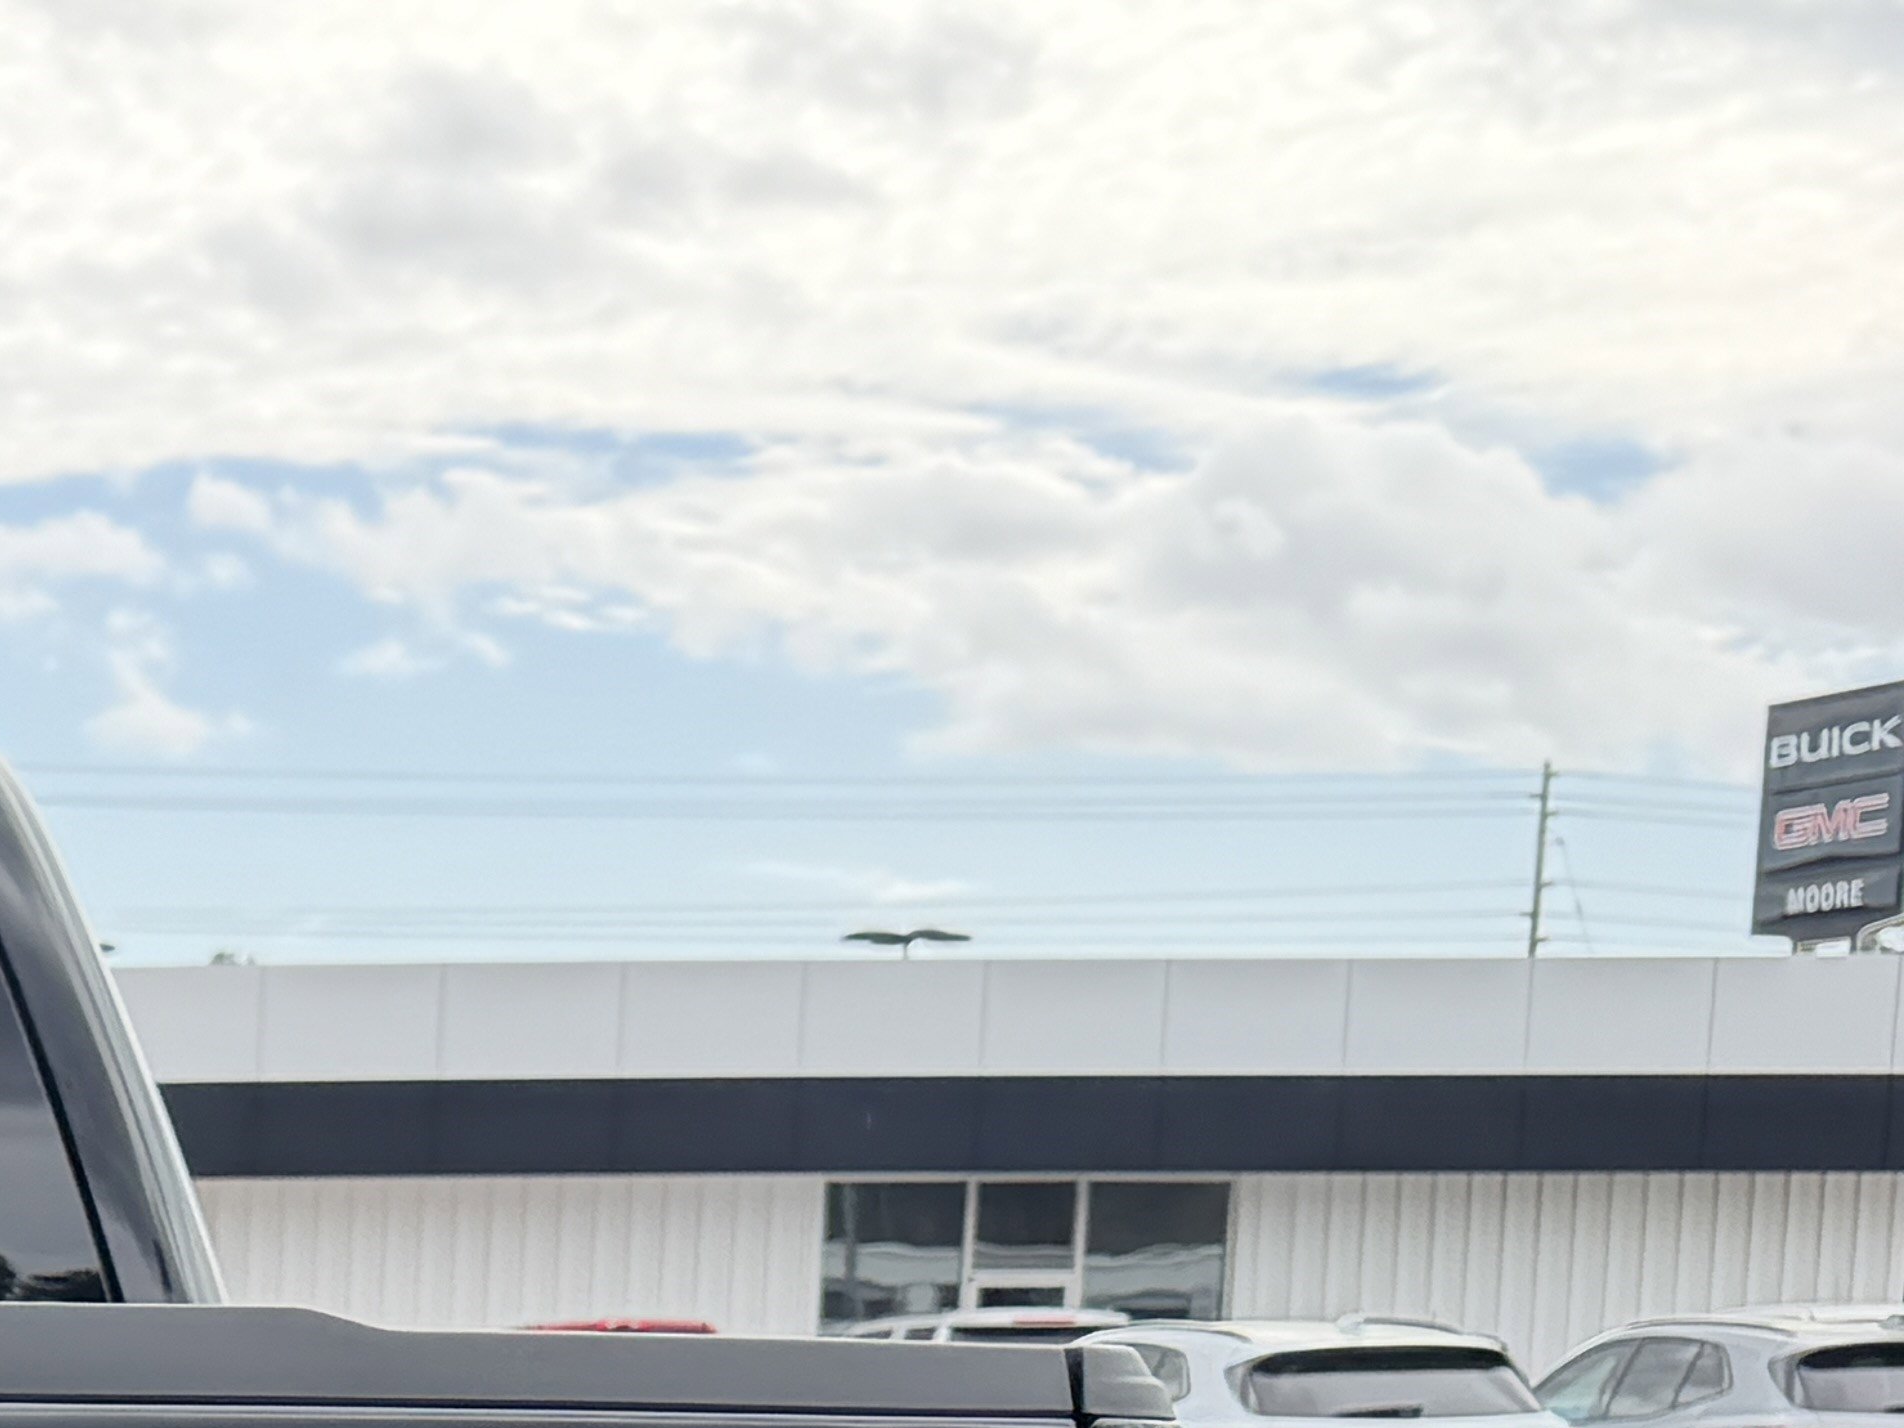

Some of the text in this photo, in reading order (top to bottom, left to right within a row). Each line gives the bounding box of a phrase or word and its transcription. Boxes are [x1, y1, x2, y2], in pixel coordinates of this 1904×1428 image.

[1768, 715, 1903, 768] BUICK
[1773, 793, 1890, 850] GMC
[1784, 878, 1866, 916] MOORE
